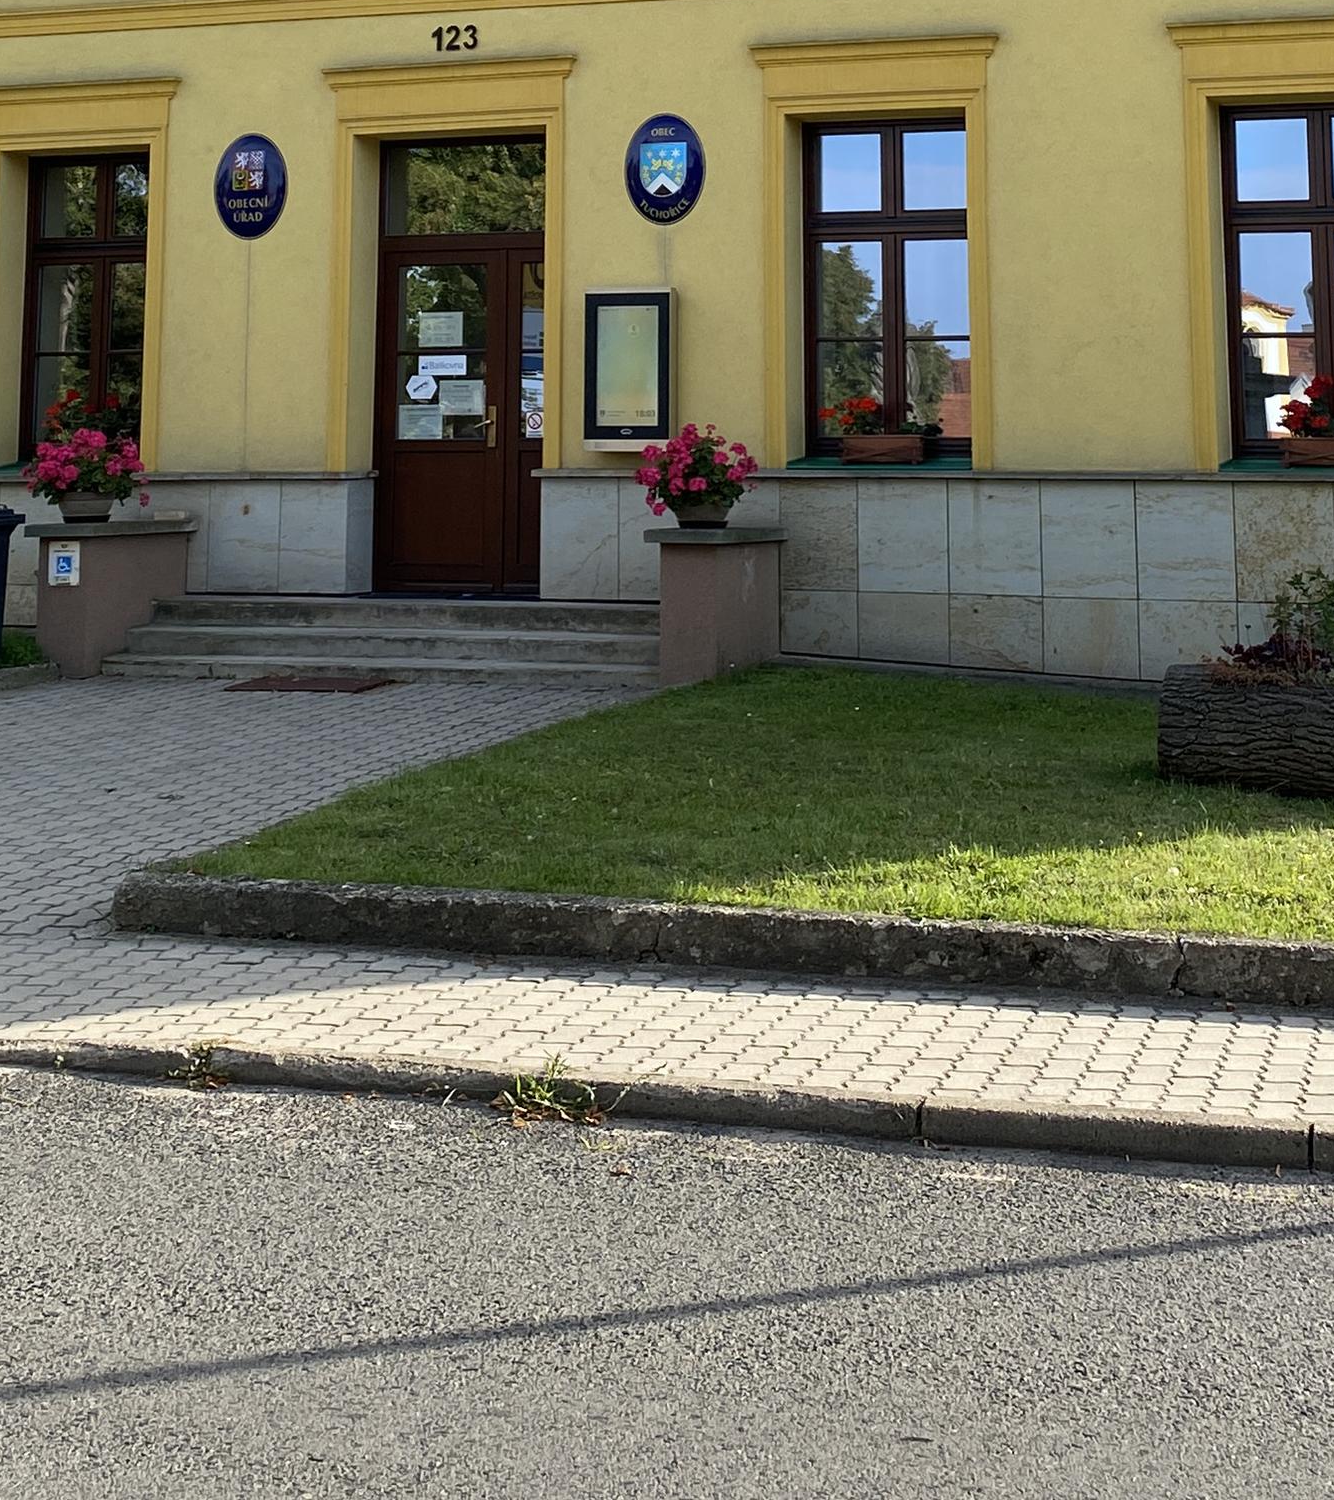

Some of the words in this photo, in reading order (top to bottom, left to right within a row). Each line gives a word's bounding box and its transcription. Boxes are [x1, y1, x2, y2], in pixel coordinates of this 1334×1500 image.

[431, 25, 478, 51] 123
[650, 127, 676, 137] OBEC
[228, 194, 268, 209] OBECNÍ
[639, 197, 690, 219] TUCHOŘICE
[233, 210, 263, 222] ÚŘAD
